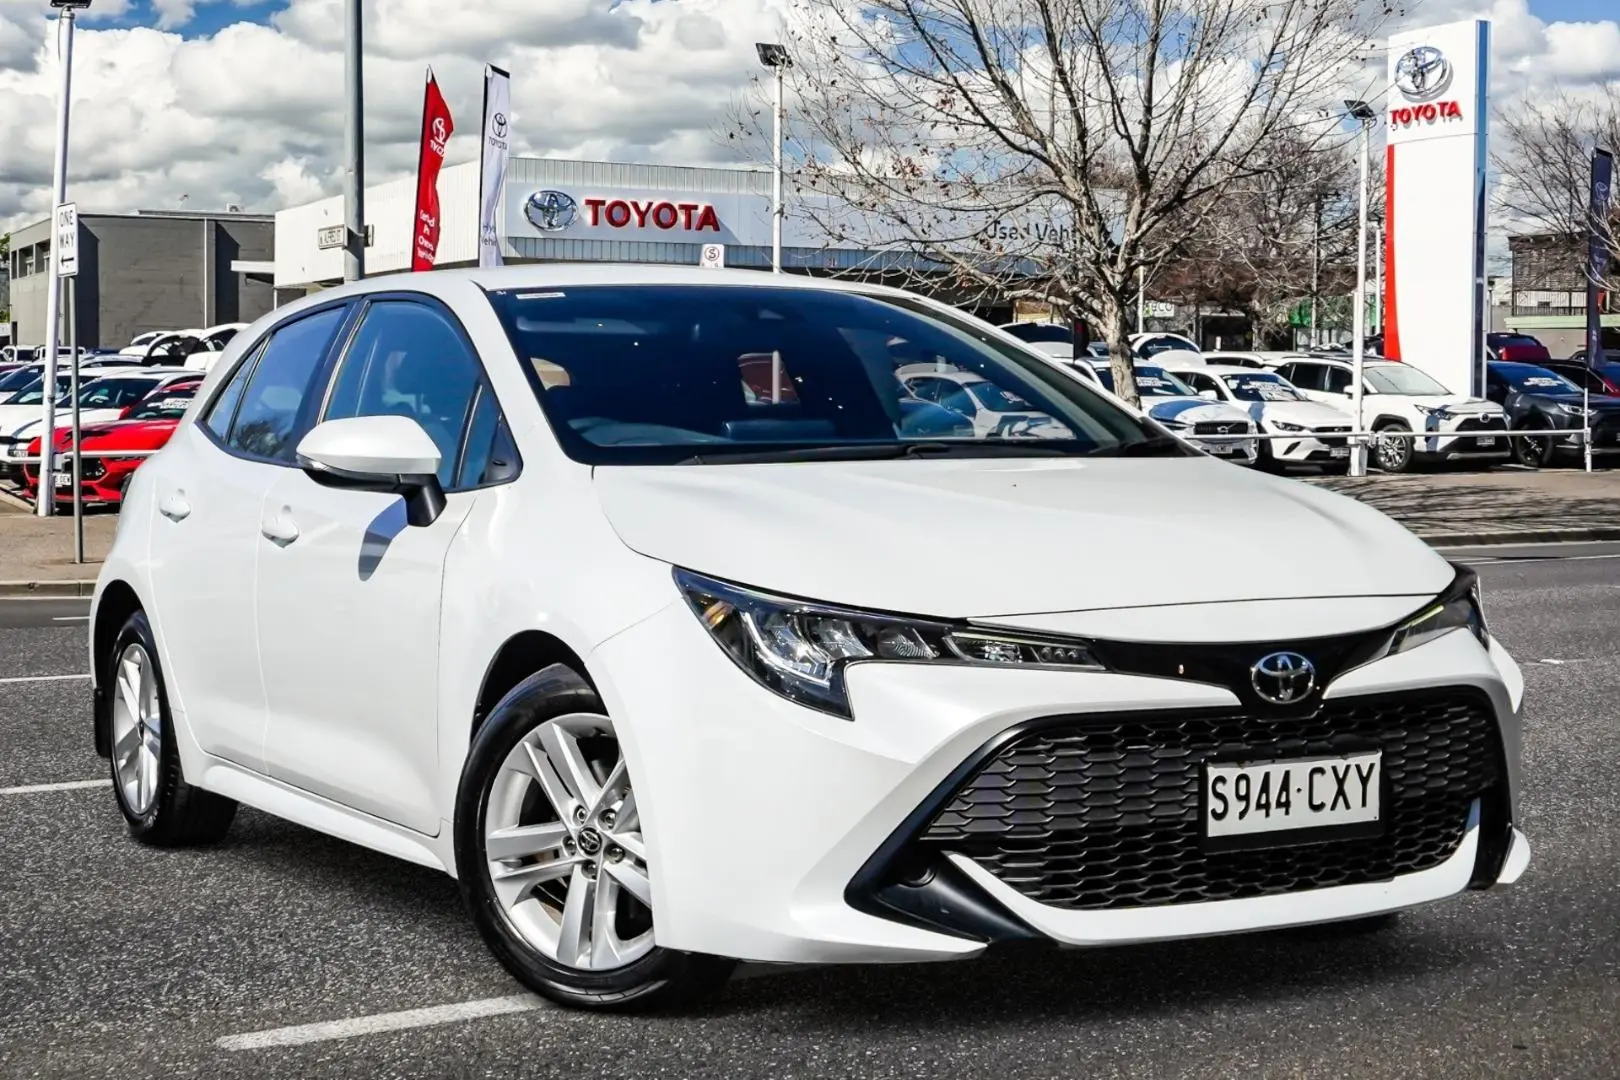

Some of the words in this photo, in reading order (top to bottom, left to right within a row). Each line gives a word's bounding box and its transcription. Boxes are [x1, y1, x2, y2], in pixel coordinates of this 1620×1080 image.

[1389, 101, 1462, 125] TOYOTA
[59, 208, 74, 227] ONE
[584, 198, 721, 232] TOYOTA
[59, 232, 75, 248] WAY
